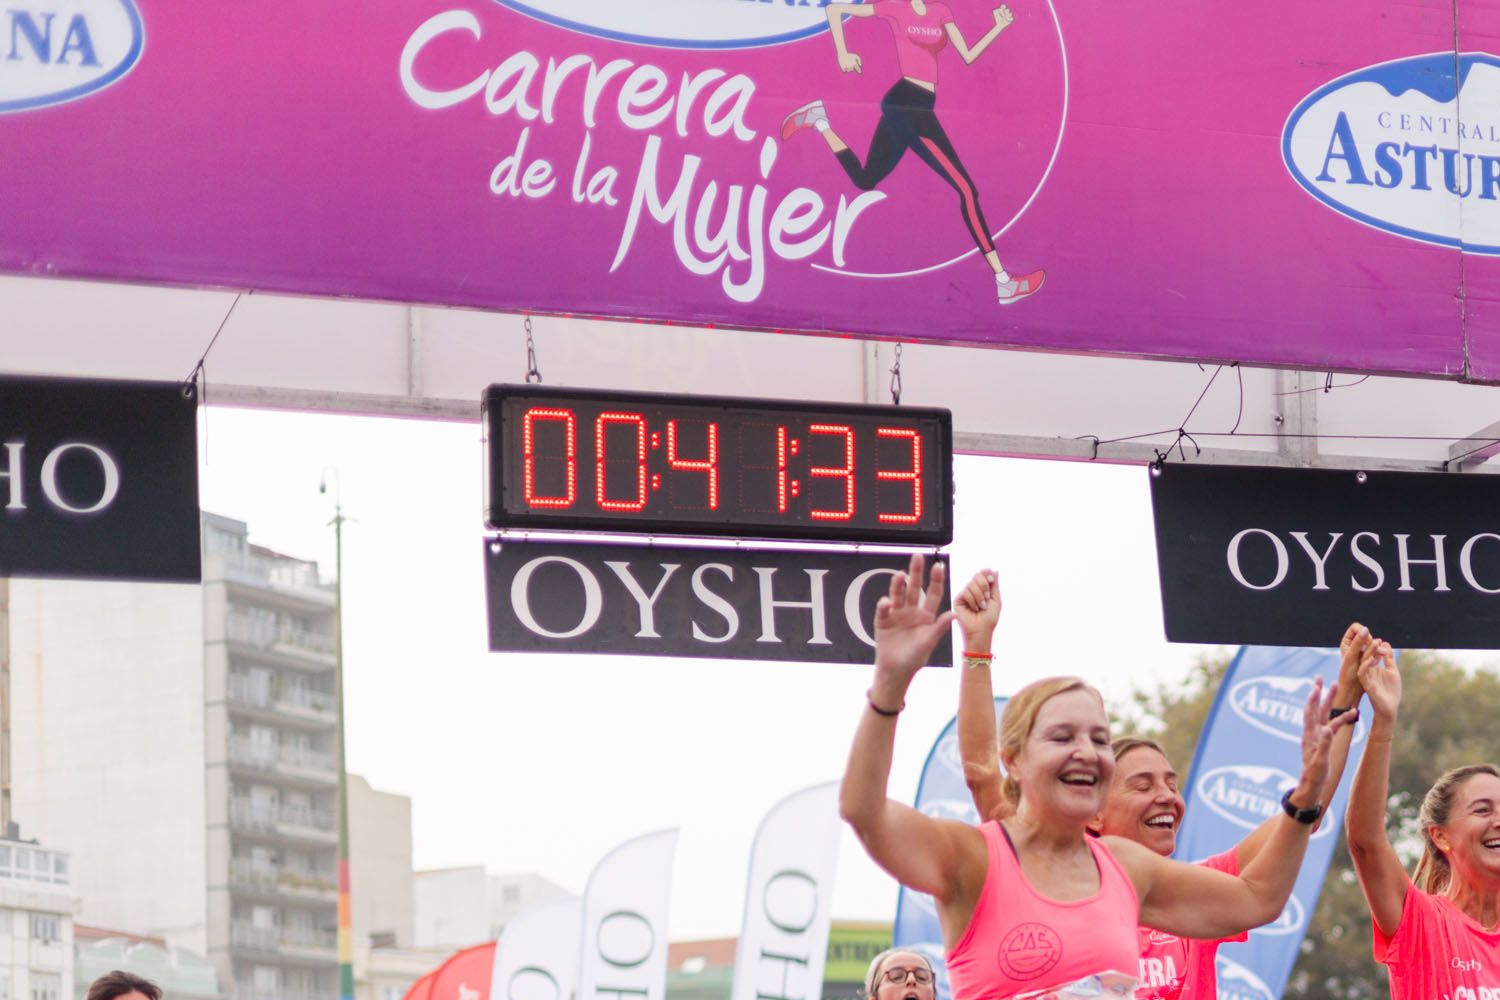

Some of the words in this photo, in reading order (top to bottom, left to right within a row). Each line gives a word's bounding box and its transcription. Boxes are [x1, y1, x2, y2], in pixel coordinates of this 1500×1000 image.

[400, 9, 758, 141] Carrera
[907, 25, 942, 37] OYSHO
[1377, 110, 1500, 143] CENTRAL
[489, 126, 557, 199] de
[571, 130, 619, 206] la
[608, 134, 888, 302] Mujer
[523, 407, 922, 523] 00:41:33
